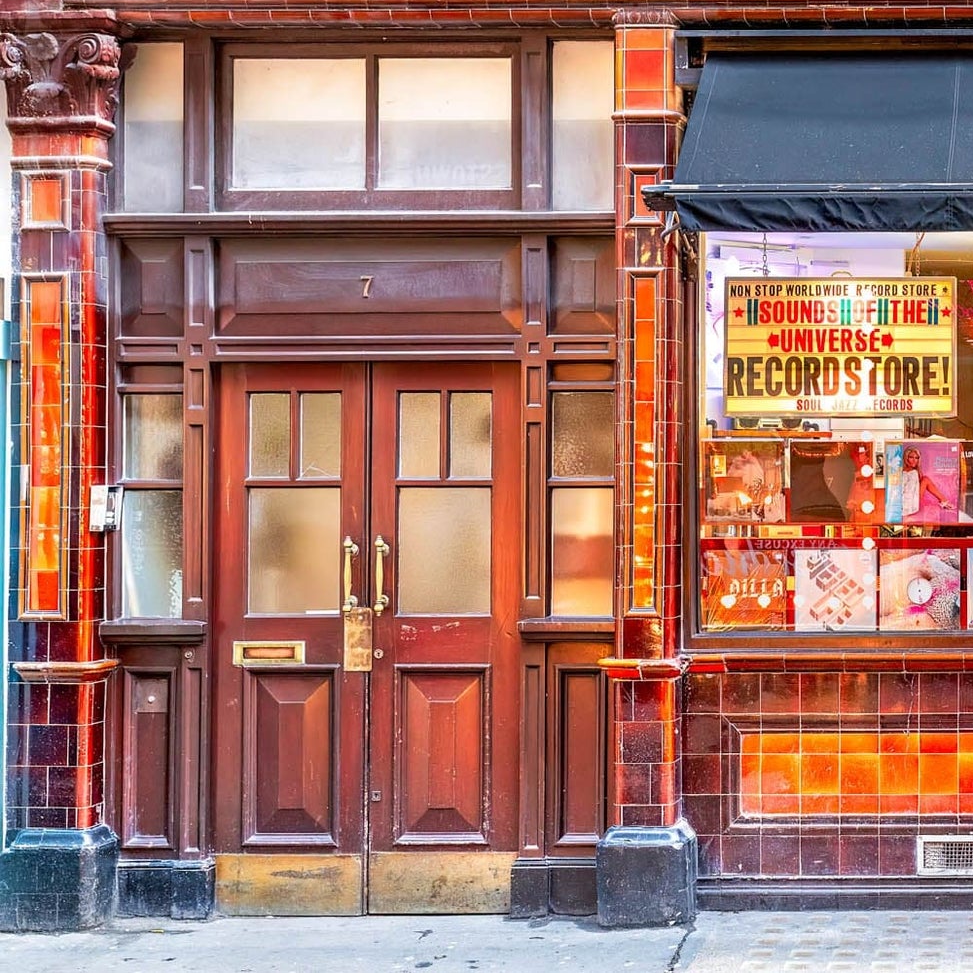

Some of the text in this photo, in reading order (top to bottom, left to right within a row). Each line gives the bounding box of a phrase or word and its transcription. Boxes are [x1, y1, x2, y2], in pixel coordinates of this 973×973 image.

[360, 275, 375, 299] 7
[730, 285, 751, 297] NON
[755, 284, 783, 297] STOP
[786, 284, 849, 297] WORLDWIDE
[902, 284, 937, 296] STORE
[759, 299, 927, 324] SOUNDS OF THE
[780, 328, 881, 353] UNIVERSE
[796, 399, 822, 411] SOUL
[865, 399, 913, 411] ECORDS
